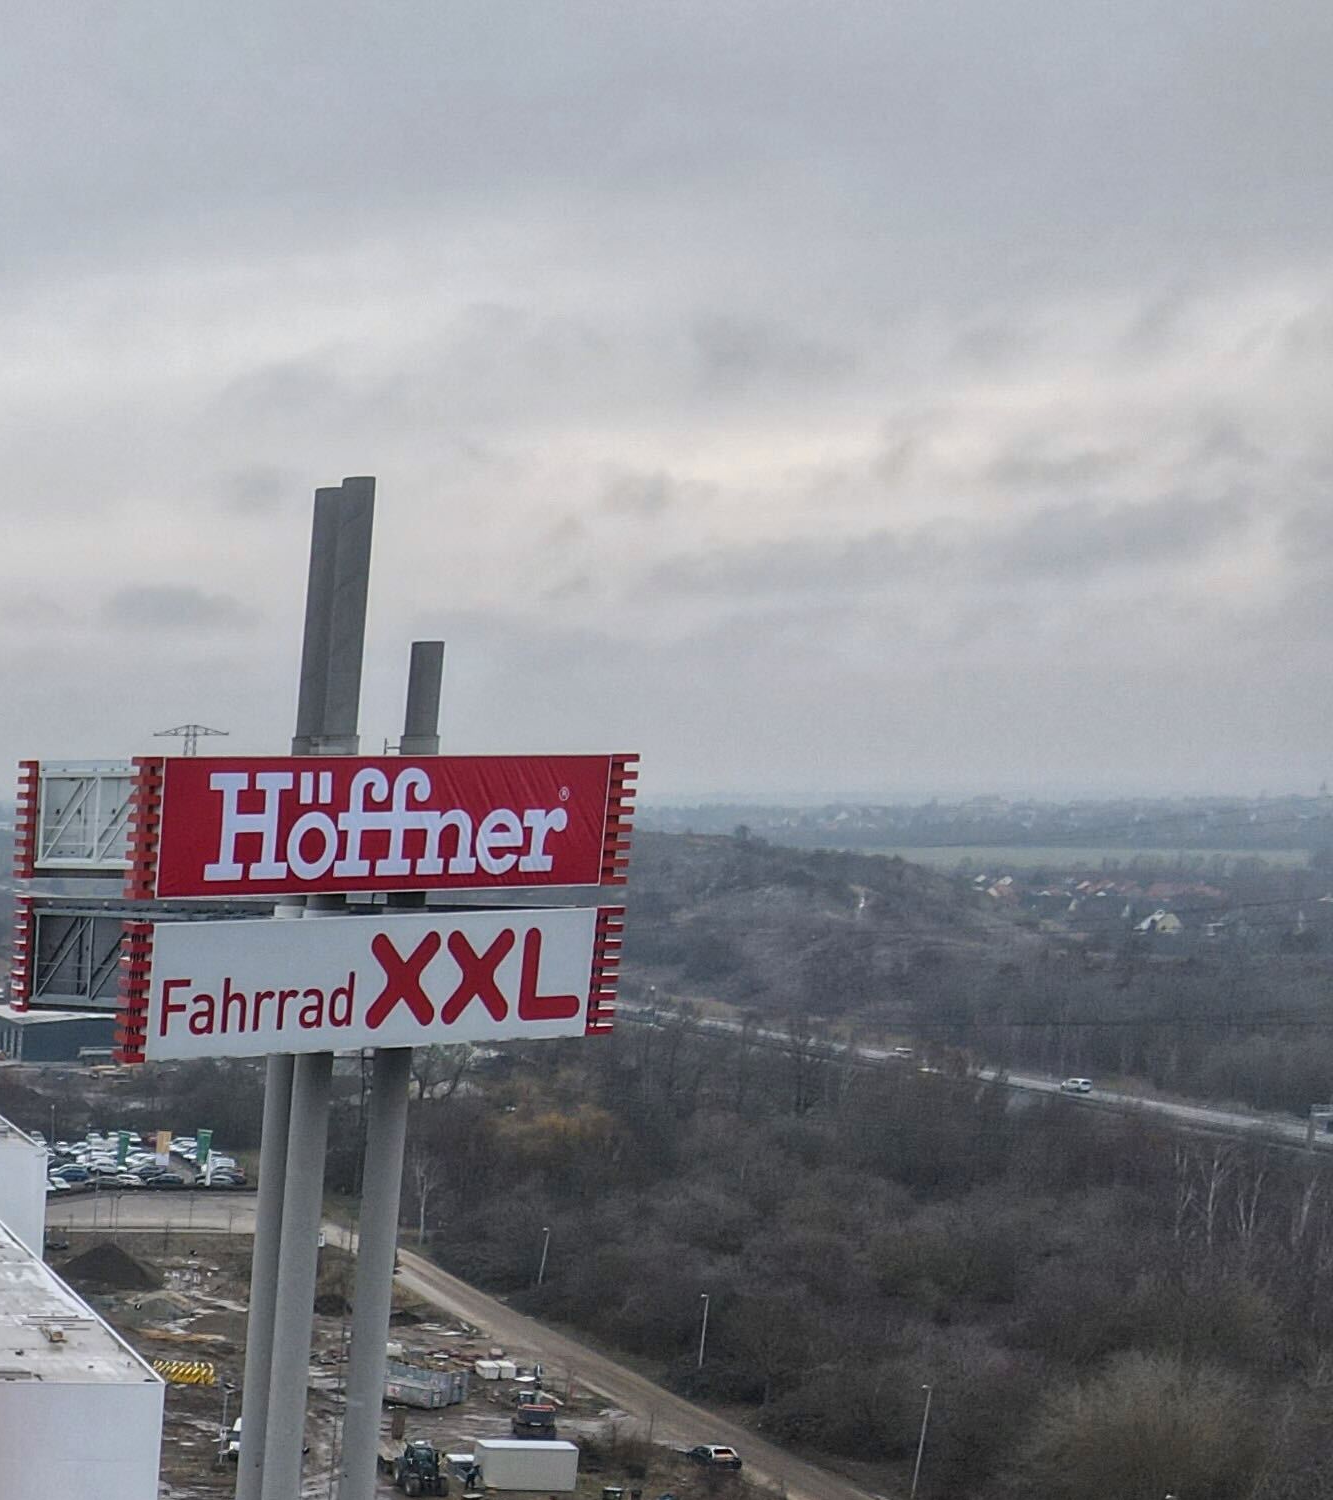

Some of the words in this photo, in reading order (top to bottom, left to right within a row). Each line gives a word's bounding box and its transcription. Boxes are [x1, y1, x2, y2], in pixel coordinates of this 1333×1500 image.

[203, 767, 567, 881] Höffner
[159, 970, 356, 1037] Fahrrad
[364, 926, 580, 1030] XXL
